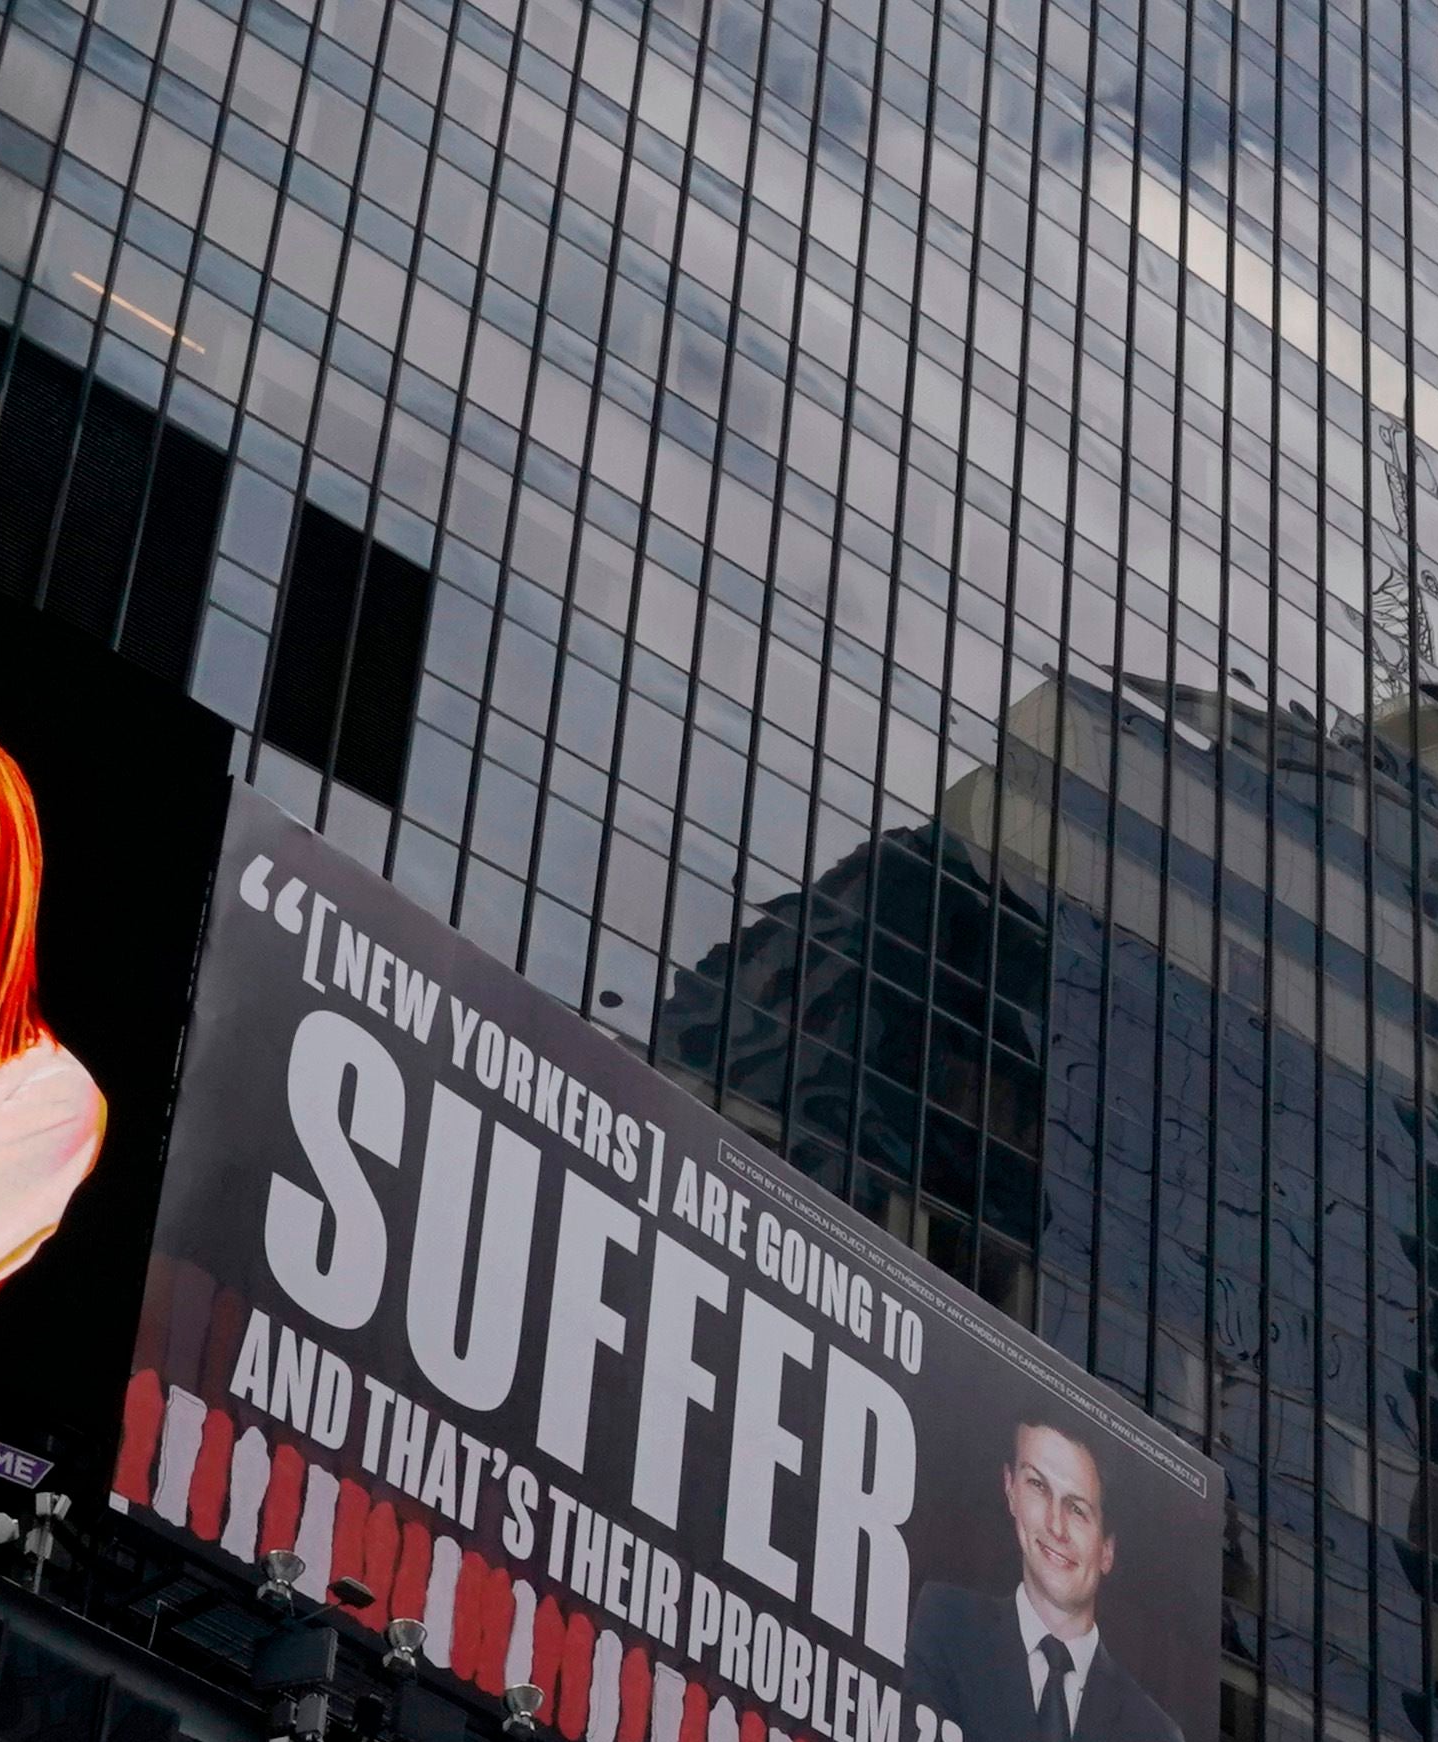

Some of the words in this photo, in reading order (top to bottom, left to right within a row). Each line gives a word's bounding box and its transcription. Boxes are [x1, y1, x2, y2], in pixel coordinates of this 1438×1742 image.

[263, 1009, 917, 1668] SUFFER
[449, 994, 666, 1217] YORKERS]
[671, 1155, 750, 1261] ARE
[755, 1211, 875, 1341] GOING
[881, 1293, 924, 1376] TO
[777, 1184, 794, 1204] THE
[793, 1195, 830, 1230] LINCOLN
[229, 1308, 354, 1451] AND
[361, 1374, 539, 1561] THAT'S
[547, 1487, 684, 1648] THEIR
